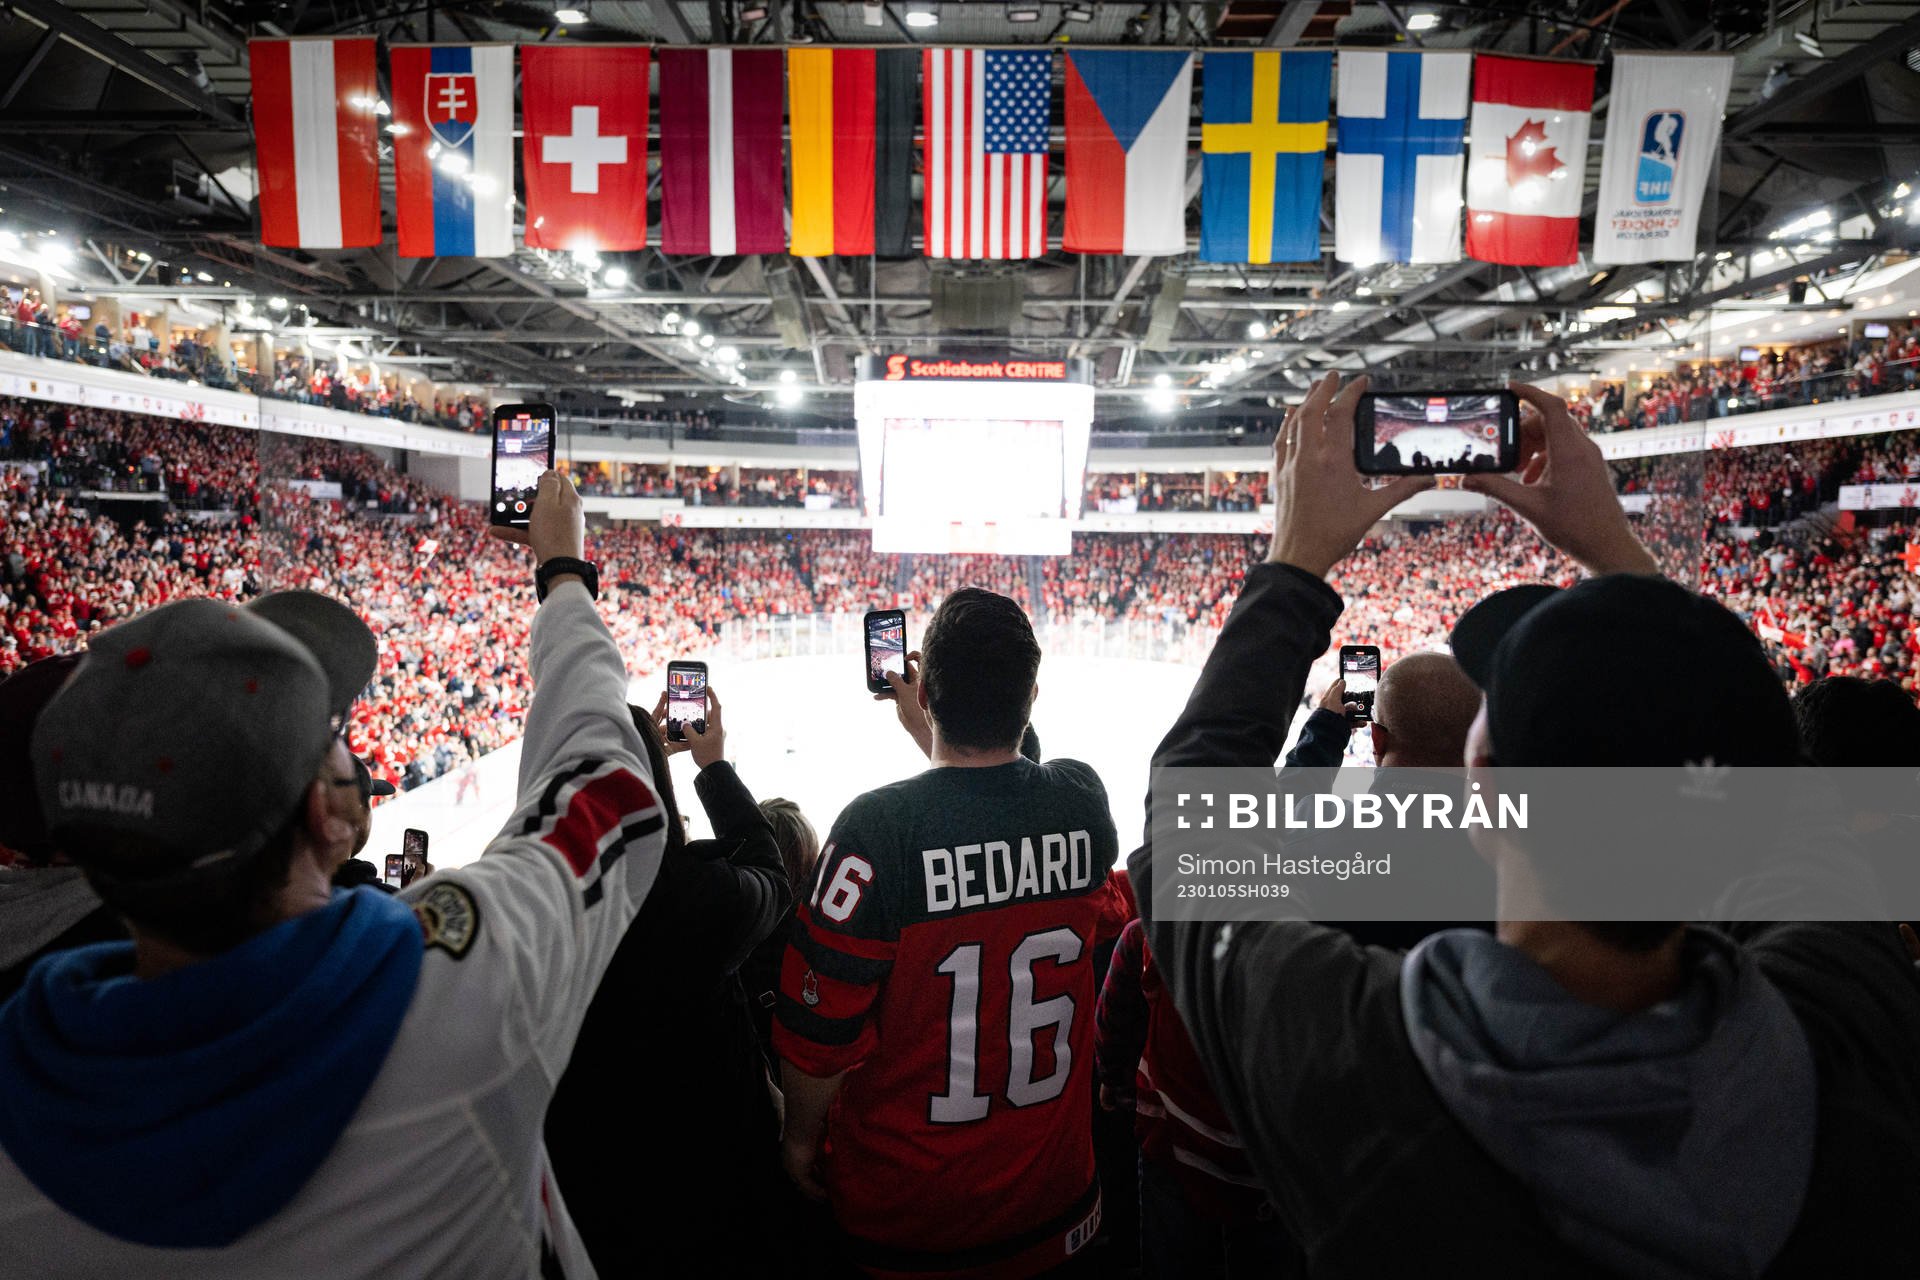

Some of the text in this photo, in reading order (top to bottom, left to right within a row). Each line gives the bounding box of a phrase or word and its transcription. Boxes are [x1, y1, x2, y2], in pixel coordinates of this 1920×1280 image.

[911, 360, 1067, 378] Scotiabank CENTRE
[810, 841, 875, 923] 16
[922, 829, 1092, 913] BEDARD
[929, 926, 1084, 1124] 16
